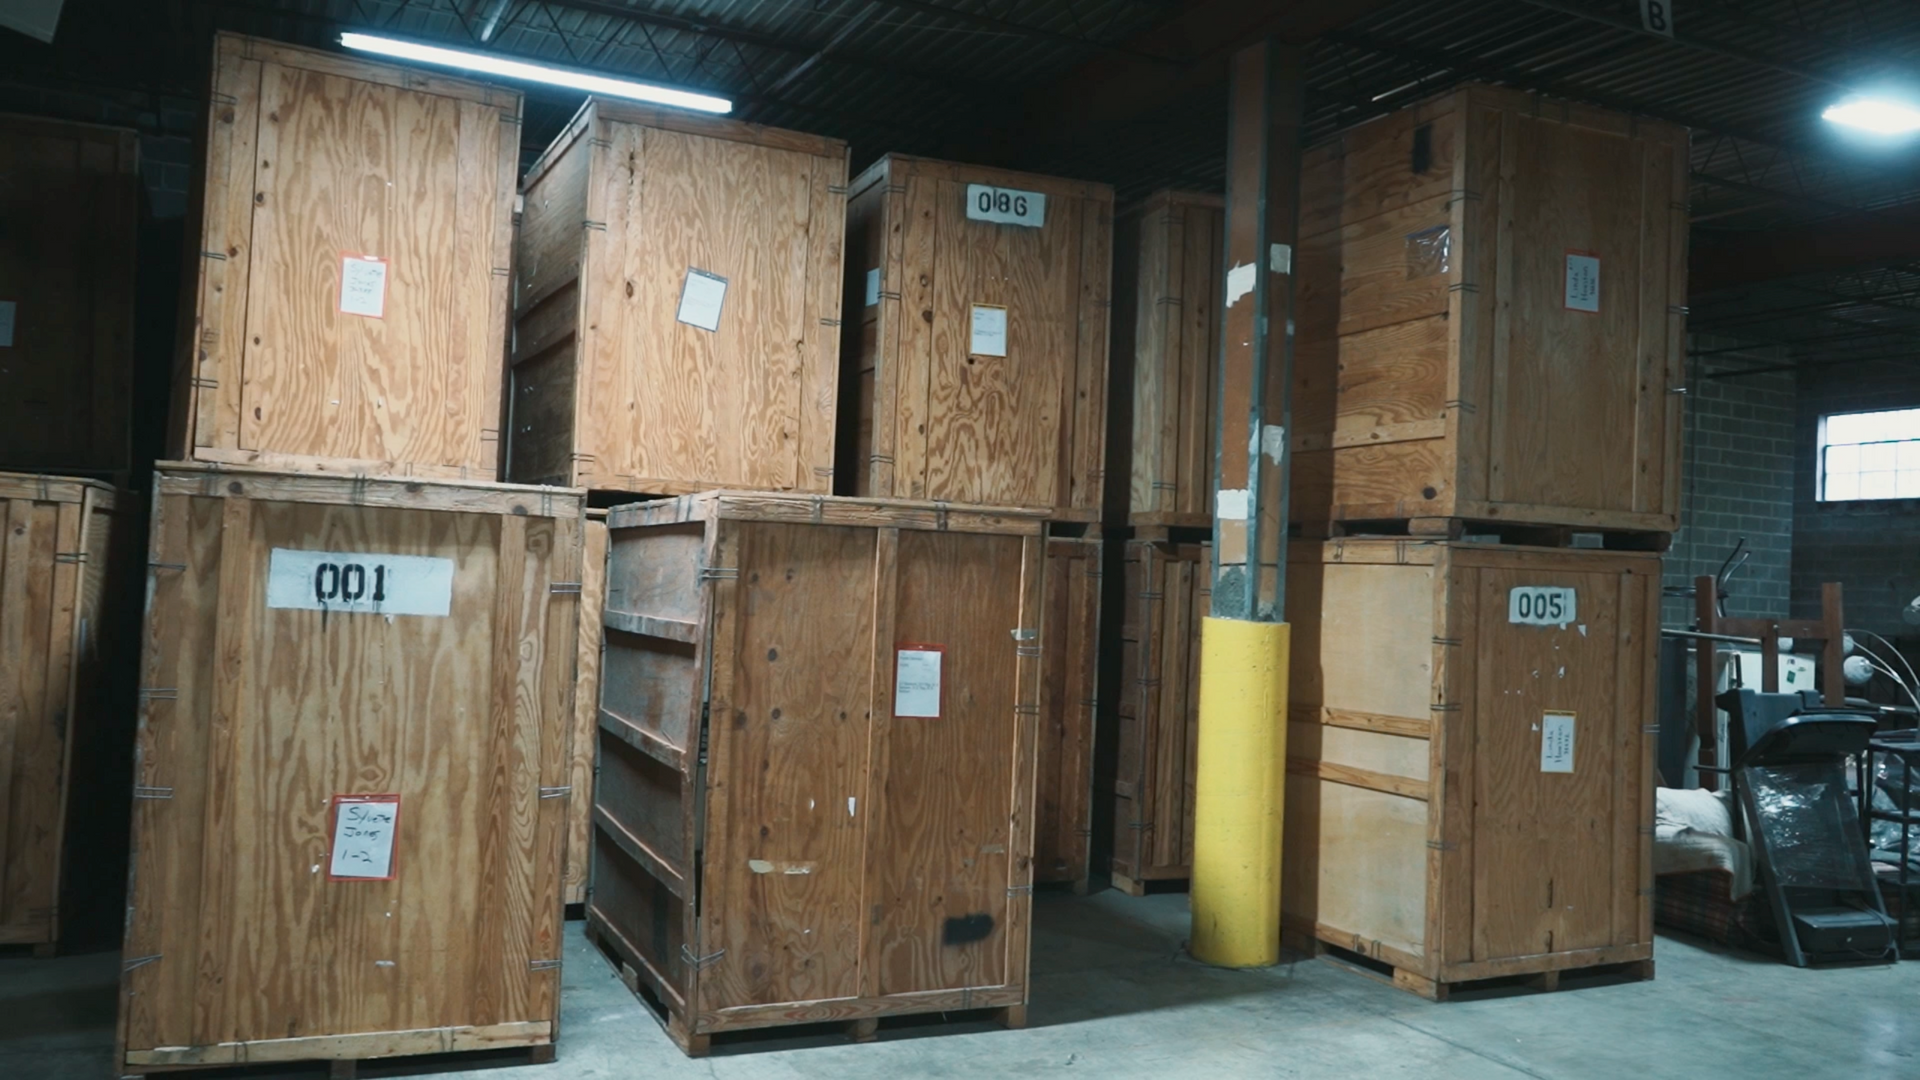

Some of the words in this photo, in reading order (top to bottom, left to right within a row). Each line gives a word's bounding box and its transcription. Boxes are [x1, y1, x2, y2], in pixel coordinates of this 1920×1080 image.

[1649, 0, 1667, 31] B
[315, 562, 386, 602] 001
[1518, 592, 1563, 619] 005
